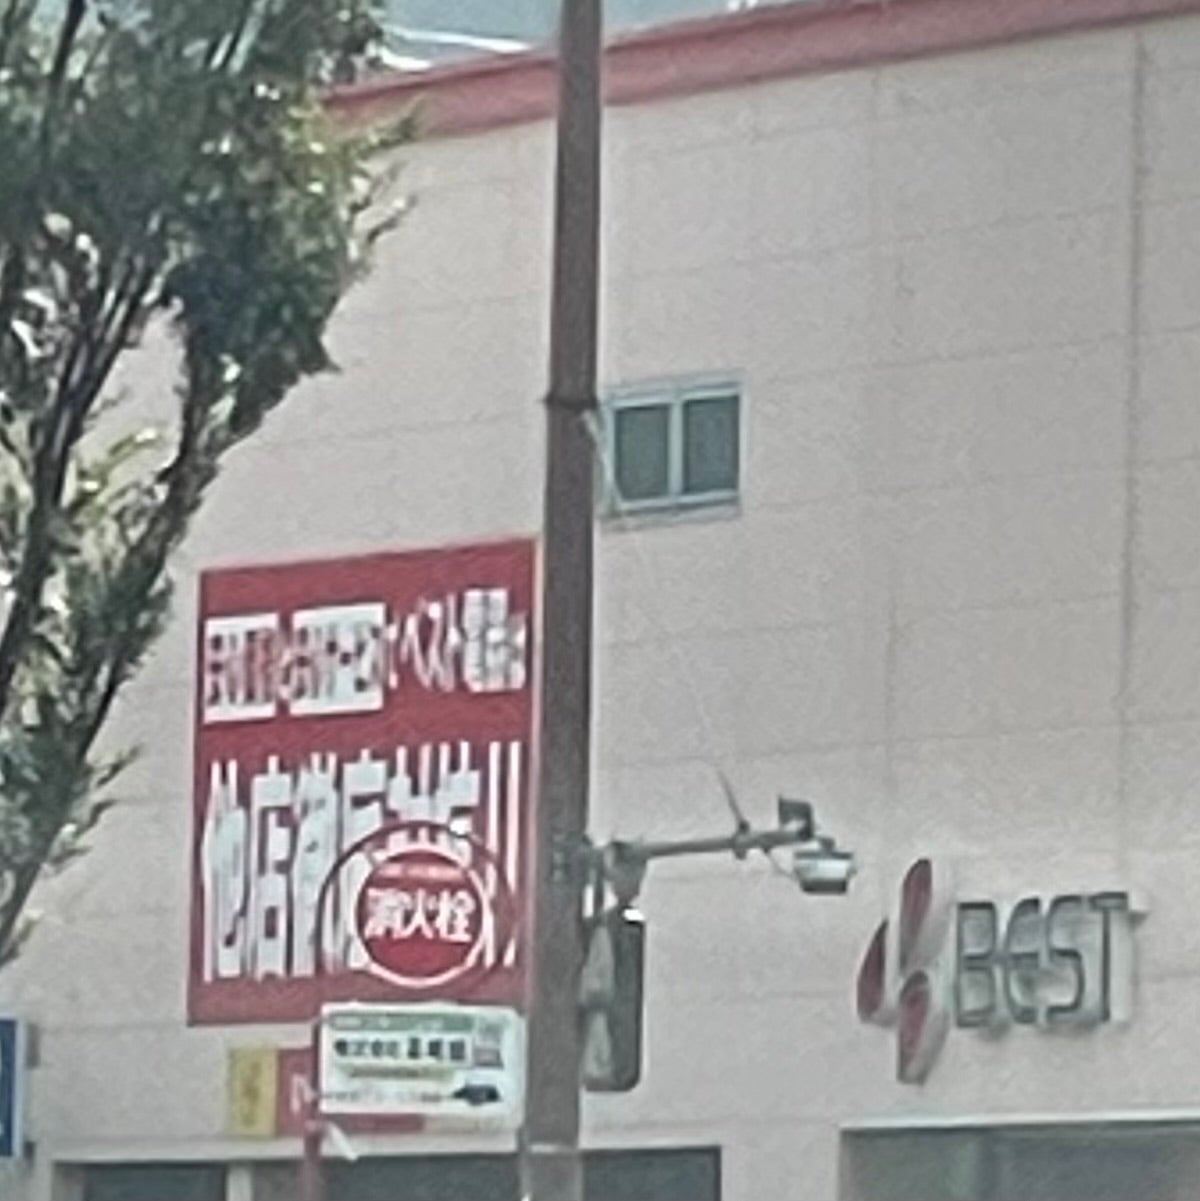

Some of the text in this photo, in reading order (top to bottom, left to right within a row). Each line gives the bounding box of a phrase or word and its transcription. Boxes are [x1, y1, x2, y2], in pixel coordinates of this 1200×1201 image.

[364, 888, 476, 943] 消火栓
[955, 892, 1130, 1029] BEST
